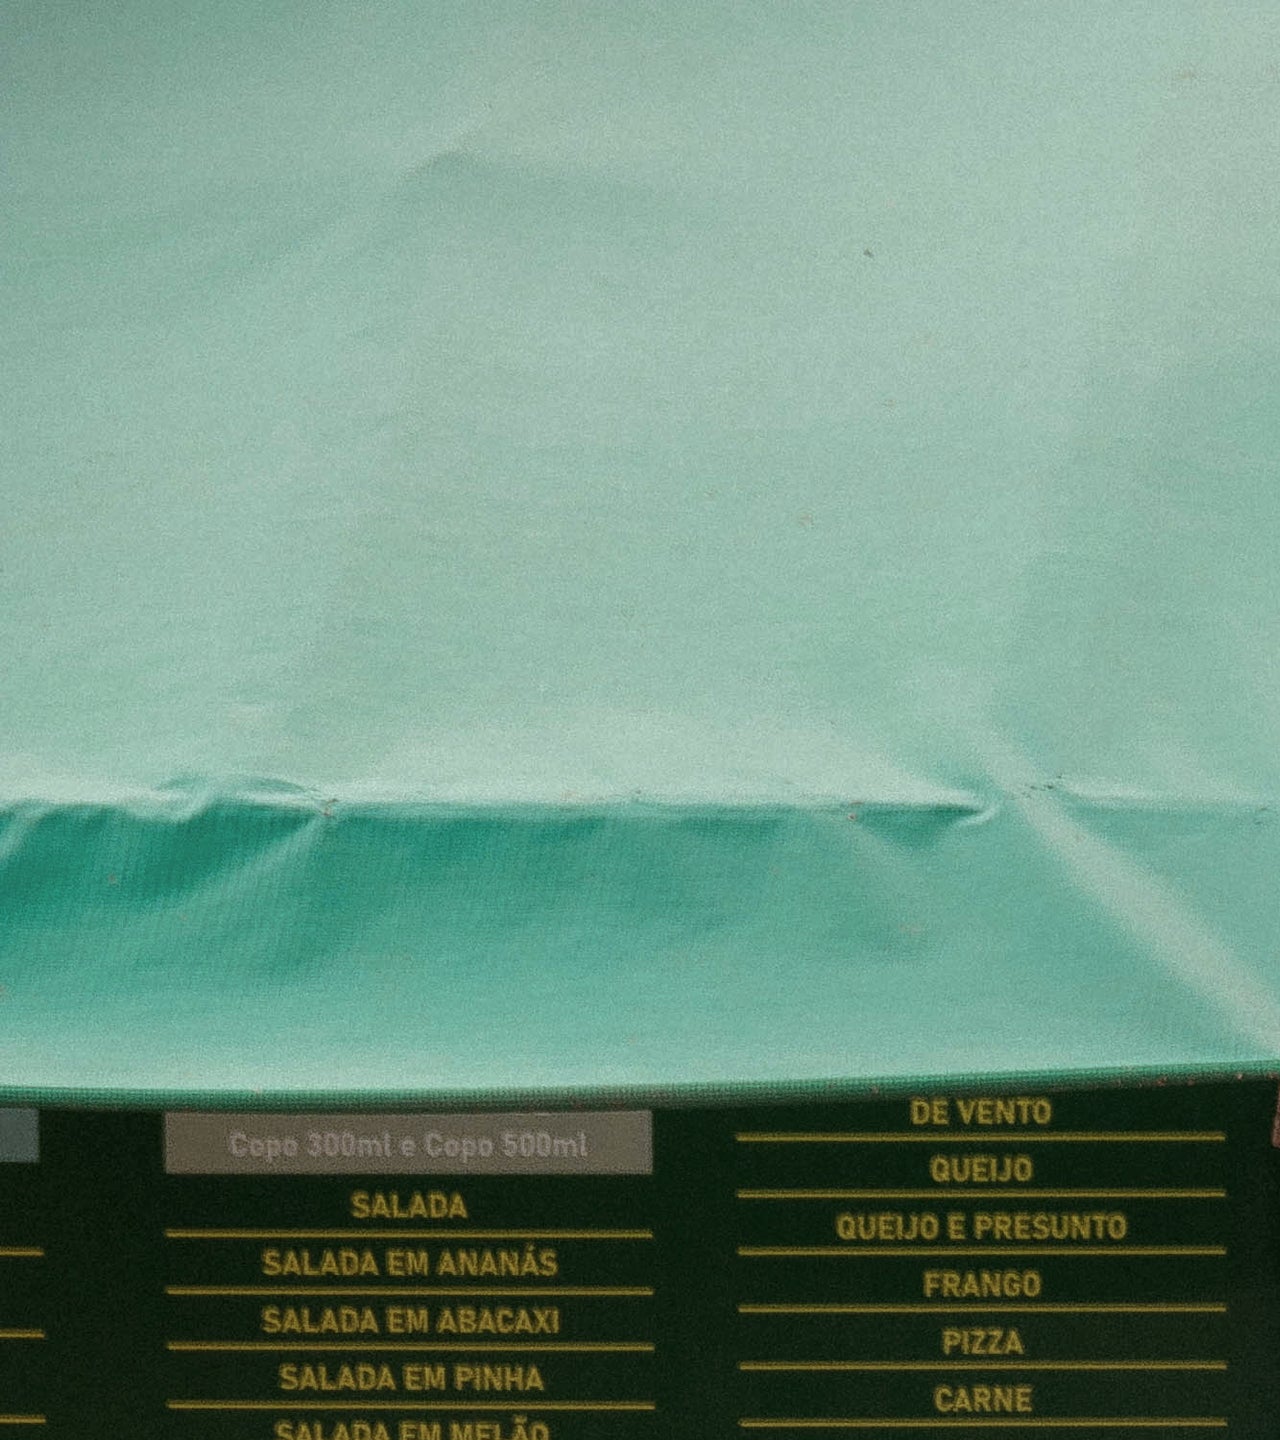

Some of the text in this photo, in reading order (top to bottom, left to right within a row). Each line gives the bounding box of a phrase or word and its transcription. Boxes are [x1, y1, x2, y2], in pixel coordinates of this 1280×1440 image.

[911, 1097, 1052, 1125] DE VENTO
[228, 1129, 588, 1164] Copo 300ml e Copo 500ml
[929, 1154, 1033, 1183] QUEIJO
[351, 1191, 468, 1219] SALADA
[836, 1212, 1127, 1240] QUEIJO E PRESUNTO
[263, 1244, 558, 1277] SALADA EM ANANÁS
[923, 1270, 1041, 1298] FRANGO
[942, 1327, 1024, 1355] PIZZA
[934, 1384, 1033, 1413] CARNE
